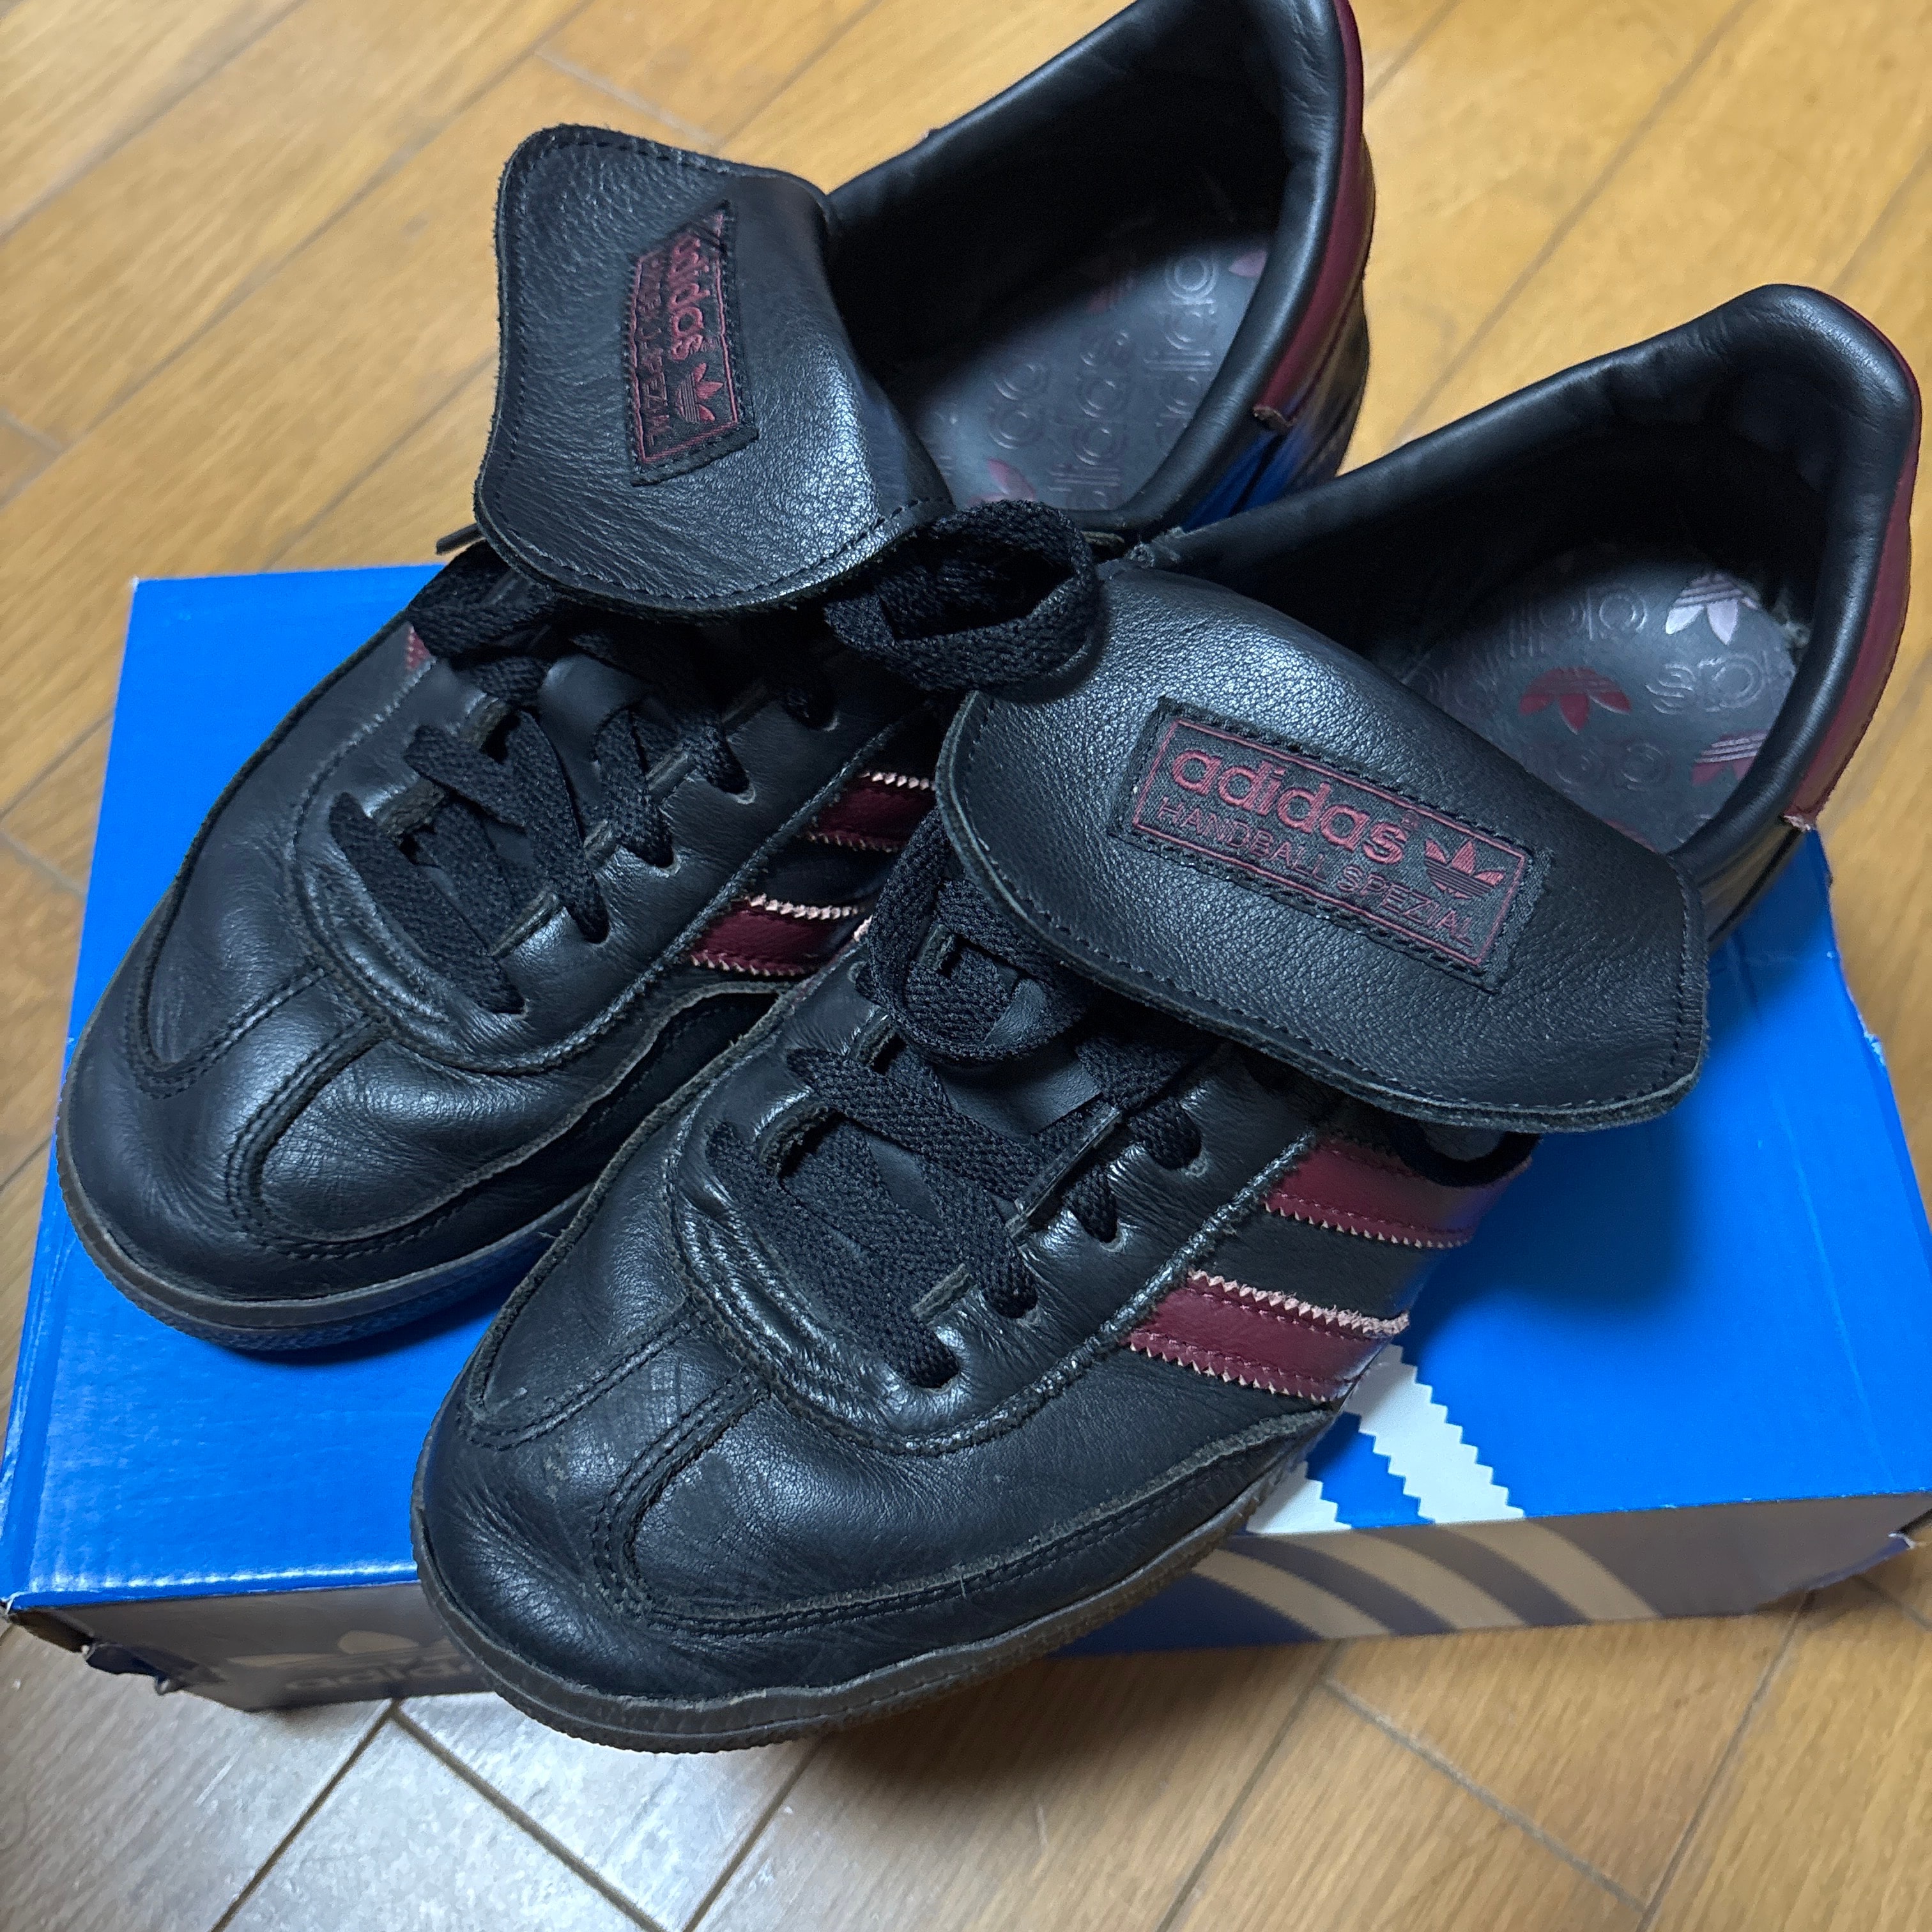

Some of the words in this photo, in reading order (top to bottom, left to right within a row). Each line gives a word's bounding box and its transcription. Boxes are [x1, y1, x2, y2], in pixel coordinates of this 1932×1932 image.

[668, 230, 711, 360] adidas
[1171, 749, 1407, 864] adidas
[1157, 797, 1328, 884] HANDBALL
[1337, 865, 1473, 948] SPEZIAL
